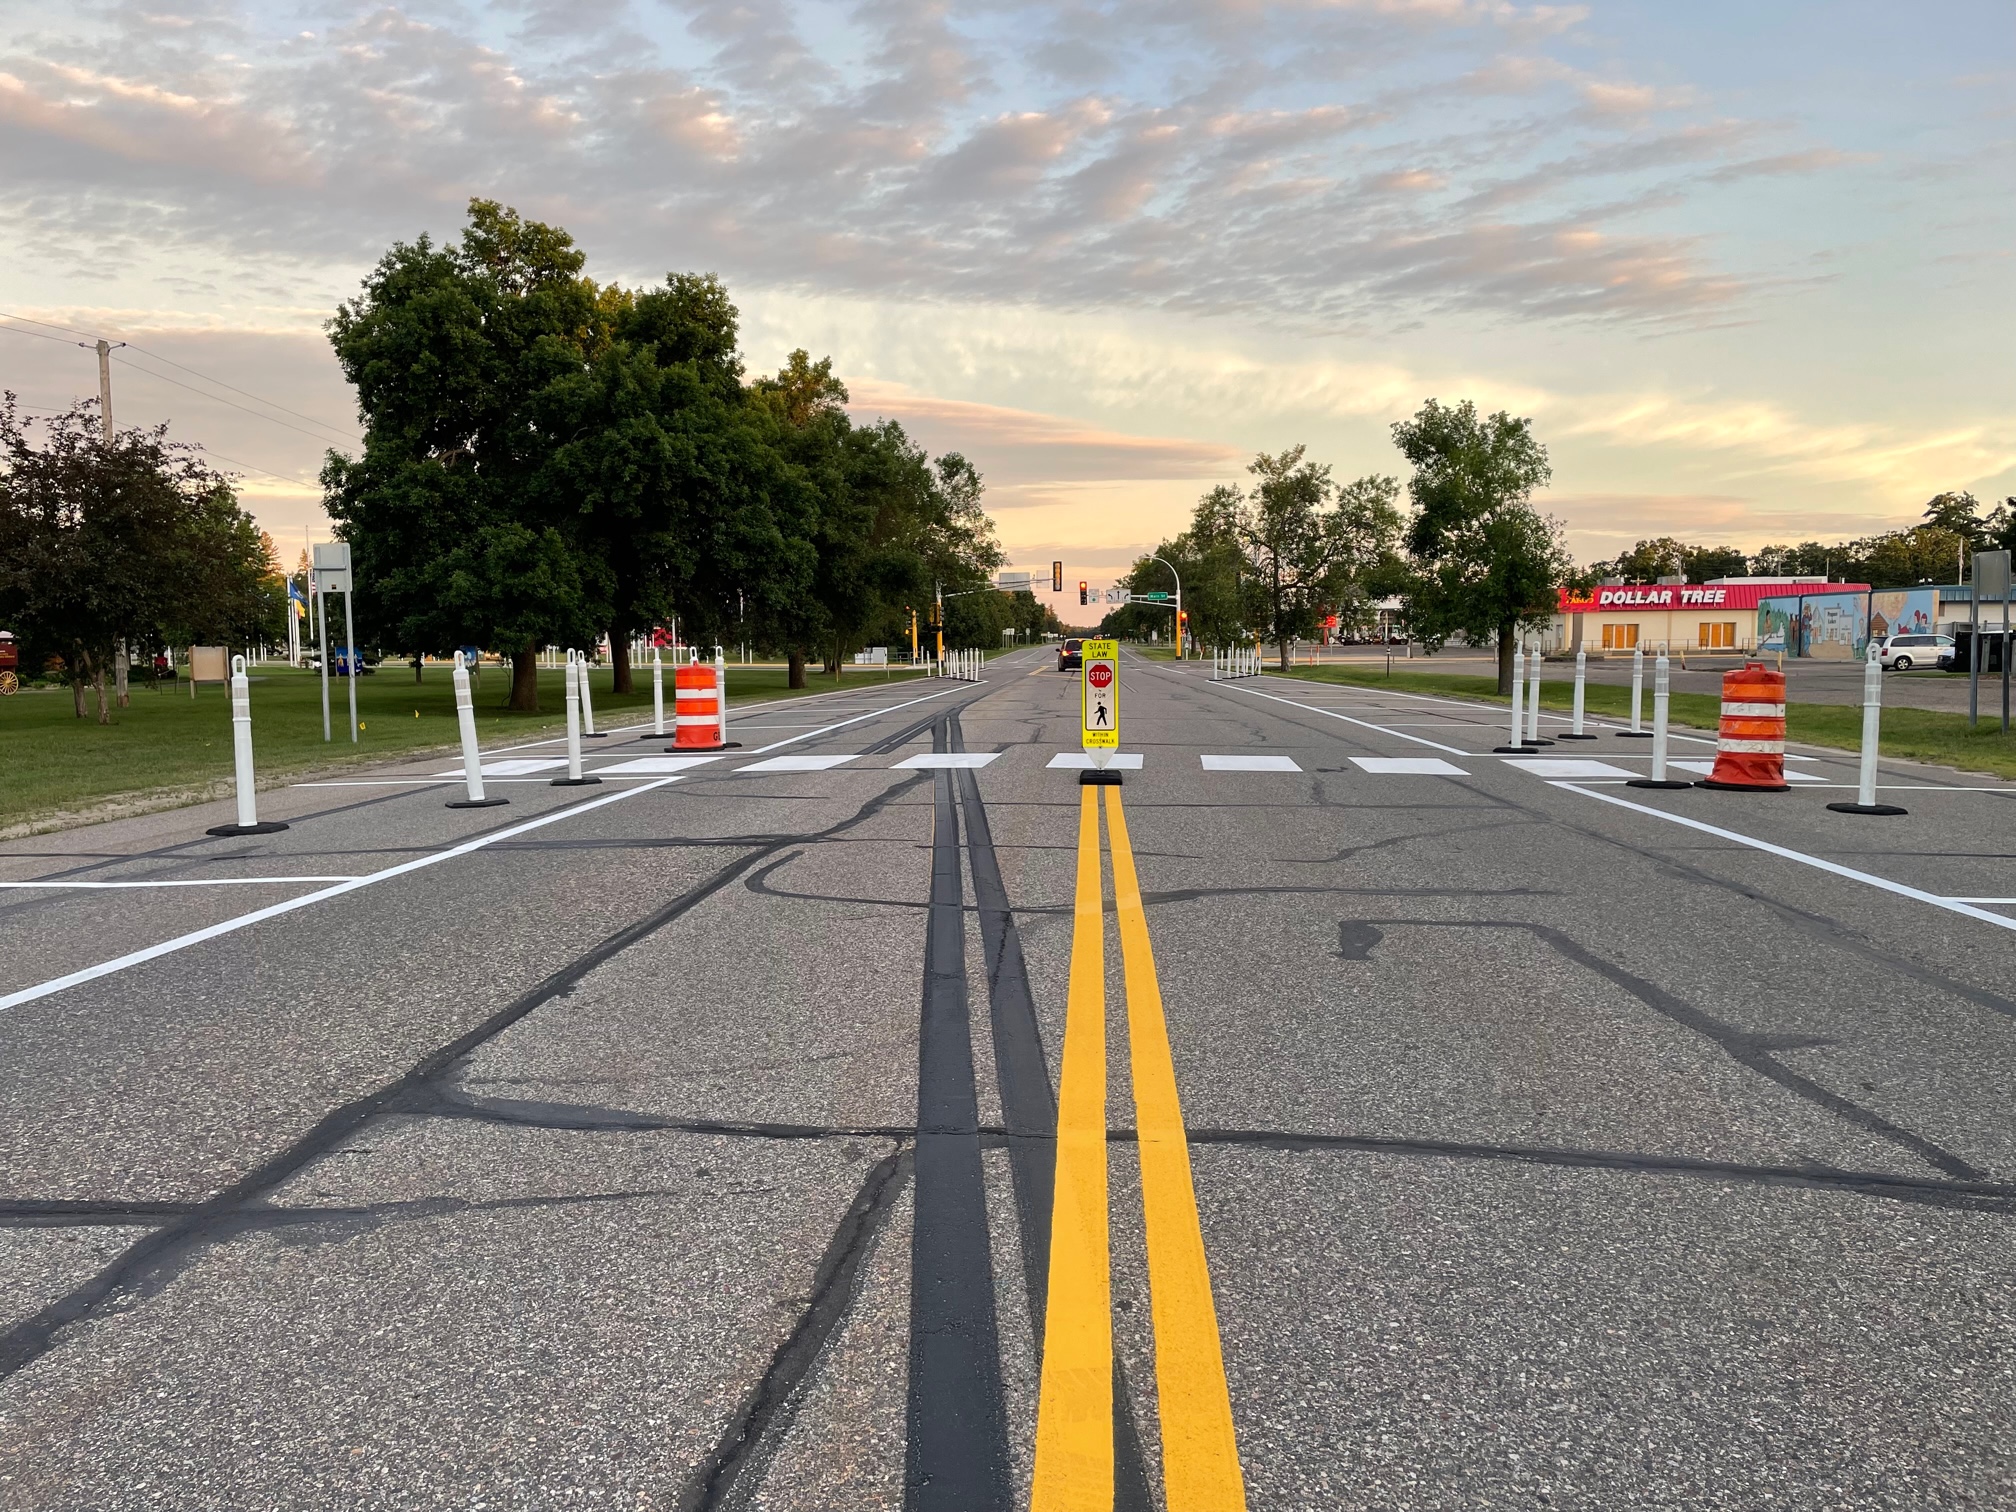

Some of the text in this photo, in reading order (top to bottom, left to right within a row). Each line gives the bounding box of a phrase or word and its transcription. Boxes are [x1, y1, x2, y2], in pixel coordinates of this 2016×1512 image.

[1600, 590, 1673, 605] DOLLAR
[1681, 589, 1727, 603] TREE
[1090, 671, 1111, 681] STOP
